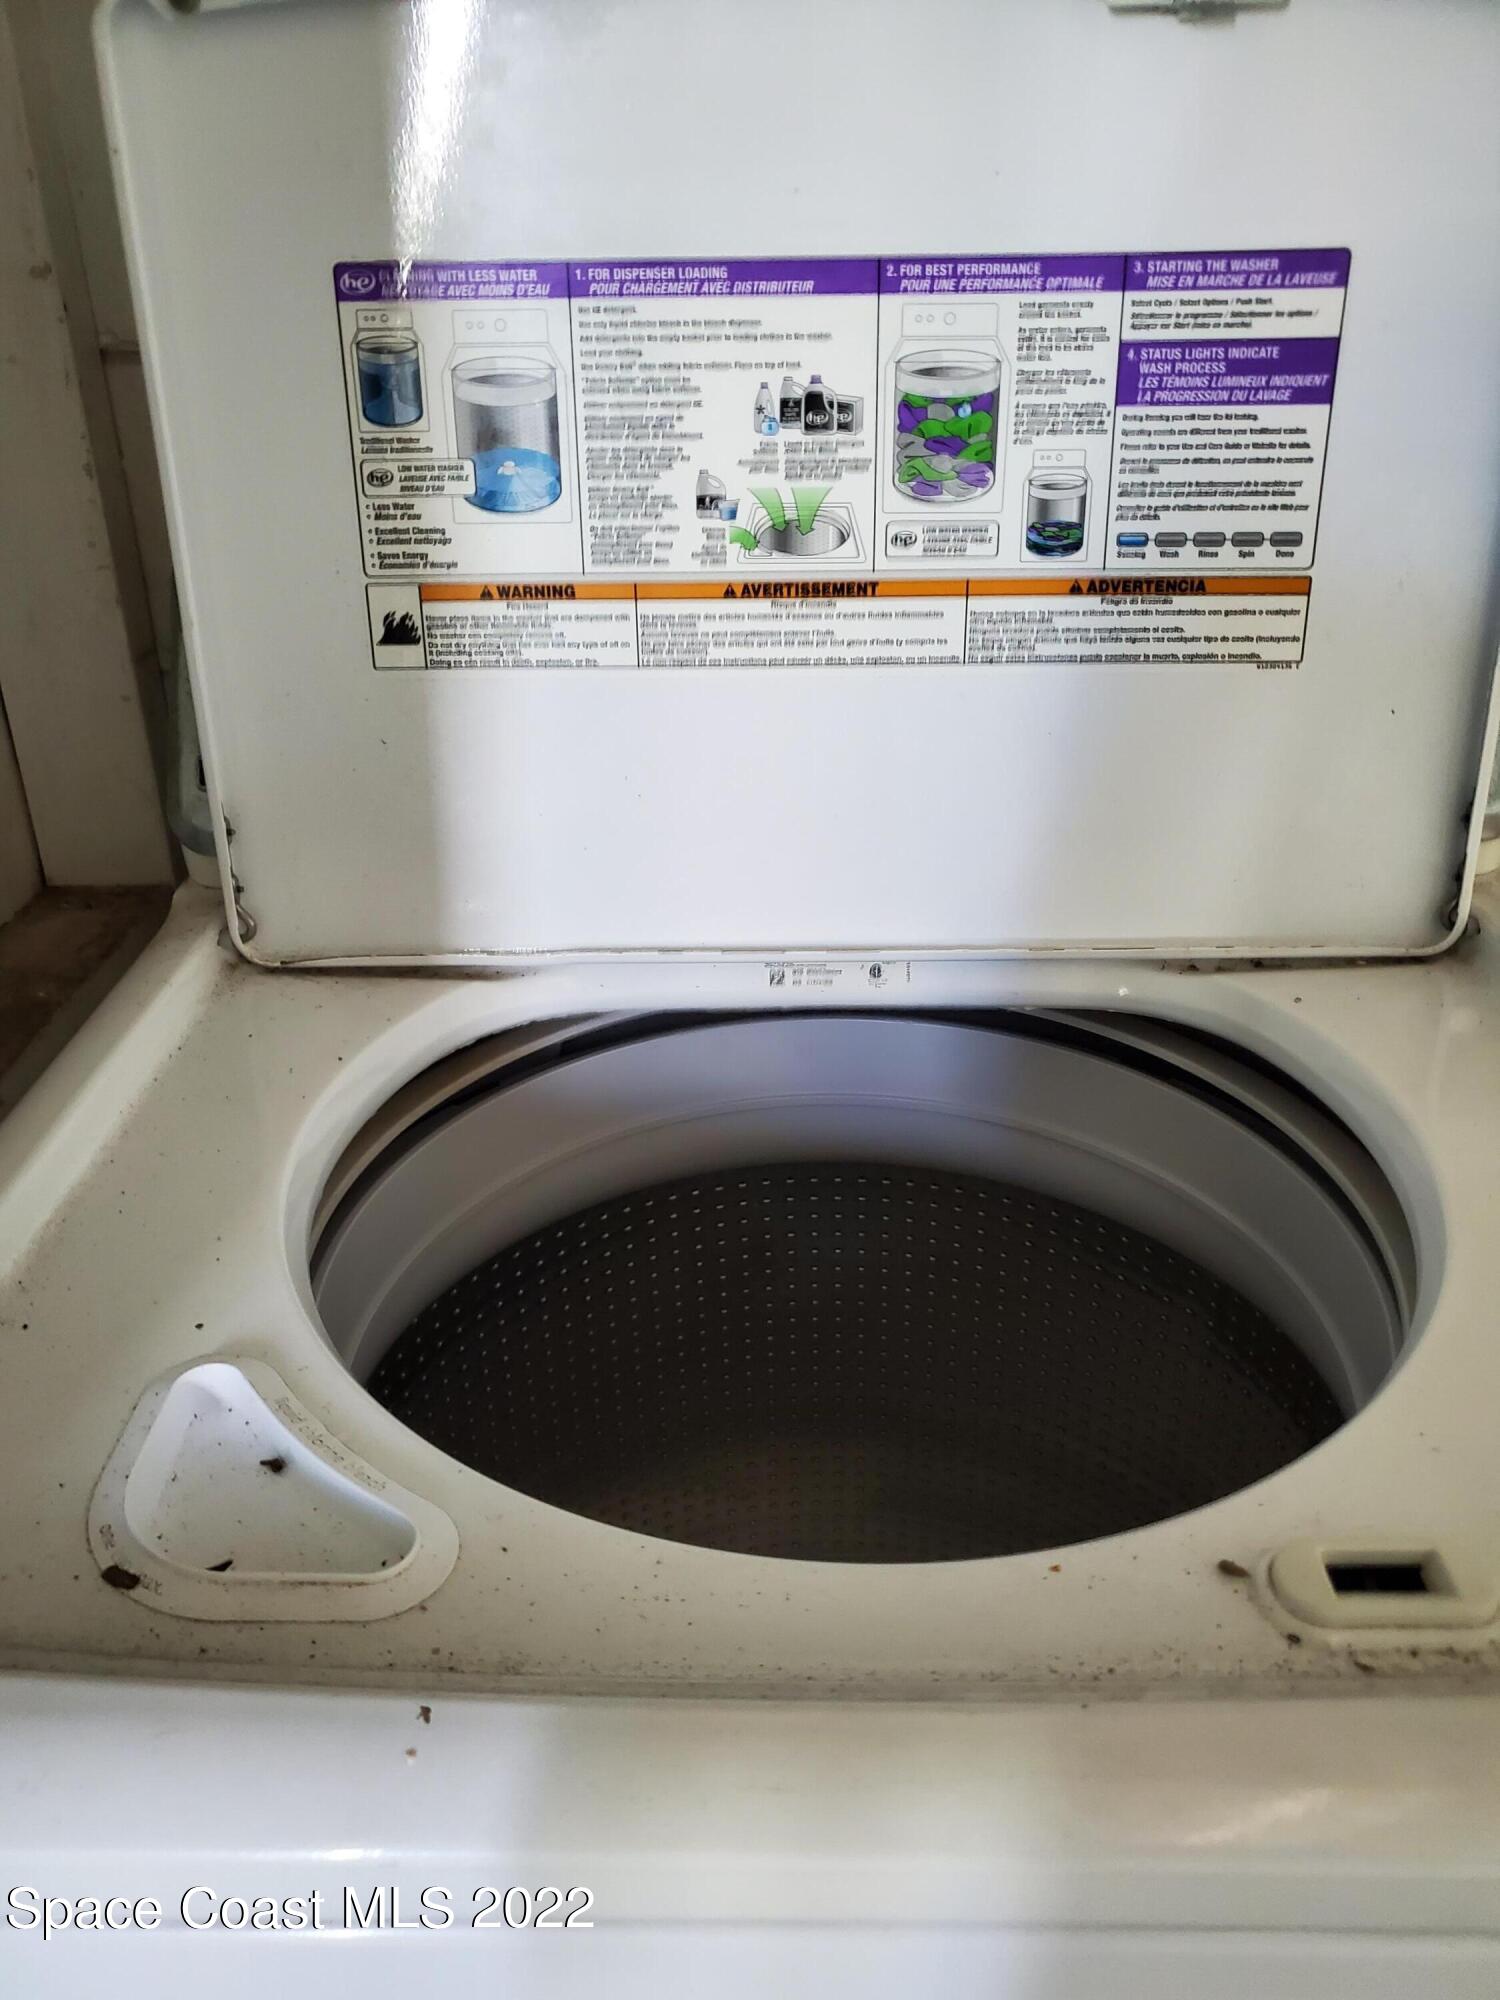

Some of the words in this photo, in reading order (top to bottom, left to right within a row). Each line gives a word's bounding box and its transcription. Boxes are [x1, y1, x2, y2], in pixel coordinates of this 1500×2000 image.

[886, 265, 897, 277] 2.
[900, 264, 922, 277] FOR
[925, 264, 954, 276] BEST
[957, 262, 1042, 276] PERFORMANCE
[1134, 261, 1145, 272] 3.
[1147, 260, 1203, 272] STARTING
[1206, 259, 1228, 271] THE
[1230, 258, 1279, 271] WASHER
[437, 269, 465, 282] WITH
[468, 269, 496, 282] LESS
[499, 269, 538, 282] WATER
[575, 269, 586, 281] 1.
[588, 268, 610, 281] FOR
[613, 267, 676, 280] DISPENSER
[678, 267, 728, 279] LOADING
[1146, 276, 1176, 288] MISE
[1178, 275, 1193, 287] EN
[1197, 274, 1246, 287] MARCHE
[1248, 274, 1264, 286] DE
[1266, 273, 1281, 285] LA
[1284, 272, 1338, 285] LAVEUSE
[447, 284, 477, 297] AVEC
[478, 284, 515, 297] MOINS
[517, 283, 550, 296] D'EAU
[589, 282, 625, 295] POUR
[623, 281, 700, 295] CHARGEMENT
[701, 281, 731, 293] AVEC
[733, 280, 815, 293] DISTRIBUTEUR
[900, 278, 935, 291] POUR
[934, 278, 957, 290] UNE
[959, 276, 1044, 290] PERFORMANCE
[1046, 275, 1105, 289] OPTIMALE
[1140, 348, 1182, 360] STATUS
[1185, 347, 1225, 359] LIGHTS
[1228, 346, 1280, 359] INDICATE
[1139, 362, 1172, 374] WASH
[1174, 361, 1226, 374] PROCESS
[1138, 376, 1159, 389] LES
[1161, 374, 1209, 388] TÉMOINS
[1211, 375, 1268, 388] LUMINEUX
[1269, 374, 1330, 387] INDIQUENT
[1137, 390, 1151, 402] LA
[1154, 389, 1231, 402] PROGRESSION
[1231, 389, 1249, 401] DU
[1250, 388, 1293, 401] LAVAGE
[392, 502, 415, 511] Water
[375, 527, 410, 535] Excellent
[412, 527, 446, 536] Cleaning
[376, 537, 412, 546] Excellent
[402, 551, 429, 561] Energy
[1159, 550, 1179, 558] Wash
[1198, 550, 1219, 558] Rinse
[1238, 550, 1255, 559] Spin
[1275, 550, 1295, 558] Done
[496, 585, 576, 599] WARNING
[740, 582, 879, 598] AVERTISSEMENT
[1087, 579, 1207, 593] ADVERTENCIA
